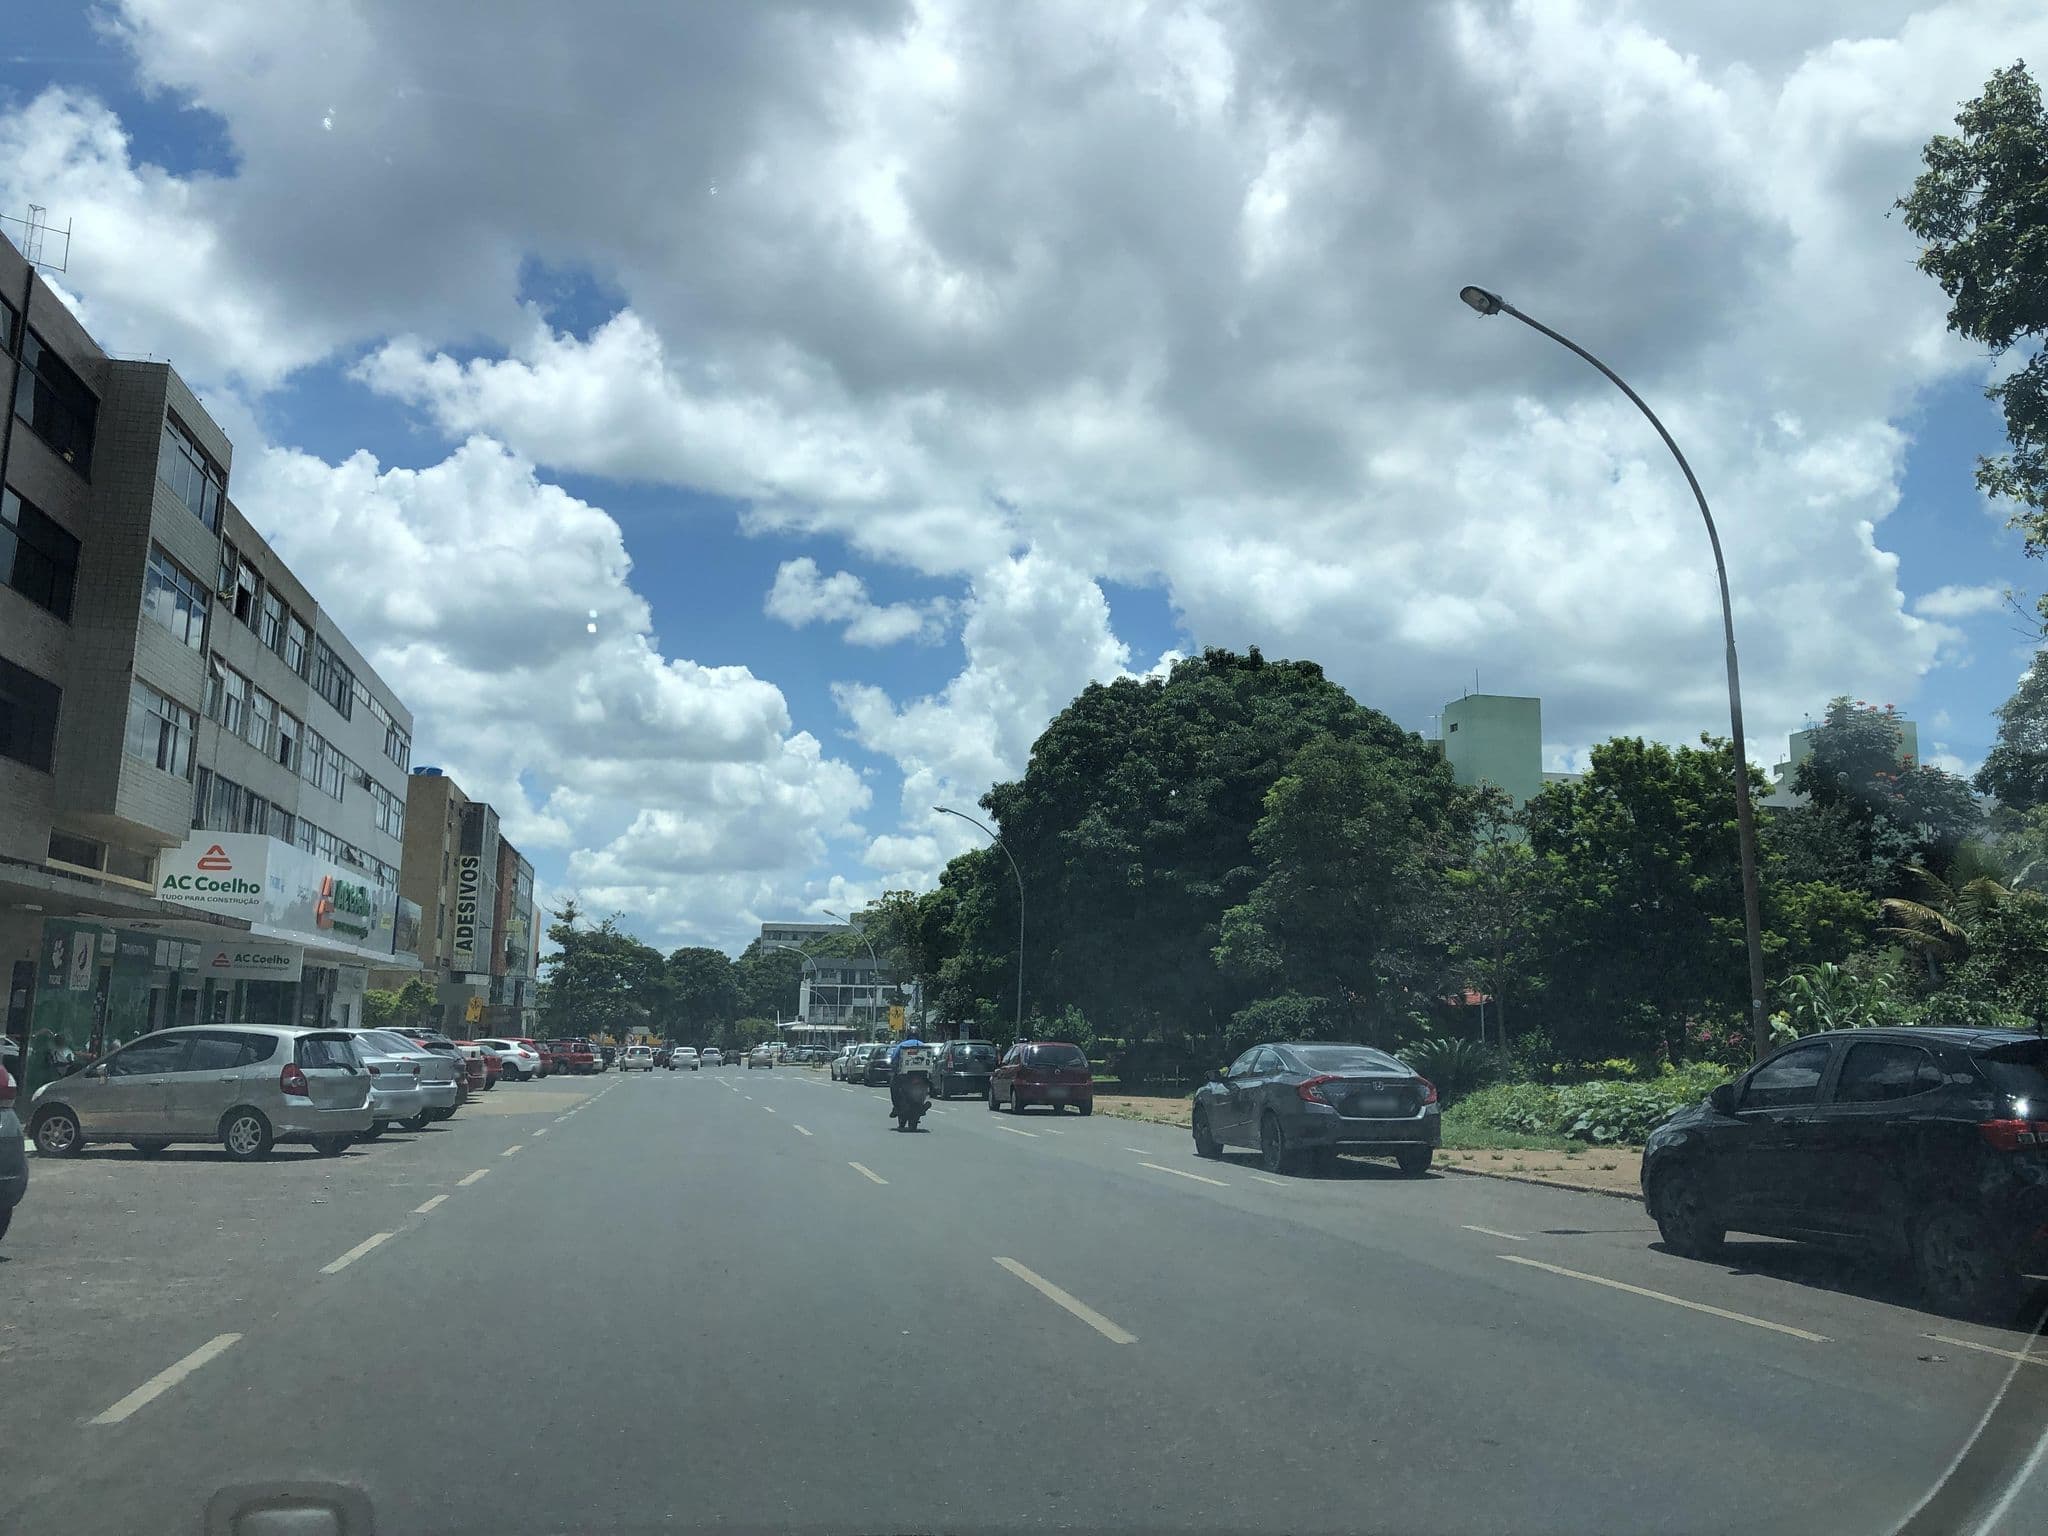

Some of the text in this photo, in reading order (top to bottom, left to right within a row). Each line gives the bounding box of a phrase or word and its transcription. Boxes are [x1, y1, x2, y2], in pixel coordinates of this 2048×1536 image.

[162, 874, 192, 890] AC
[195, 876, 261, 894] Coelho
[161, 893, 183, 901] TUDO
[207, 896, 260, 905] CONSTRUÇÃO
[455, 856, 479, 952] ADESIVOS
[234, 953, 290, 965] AC Coelho
